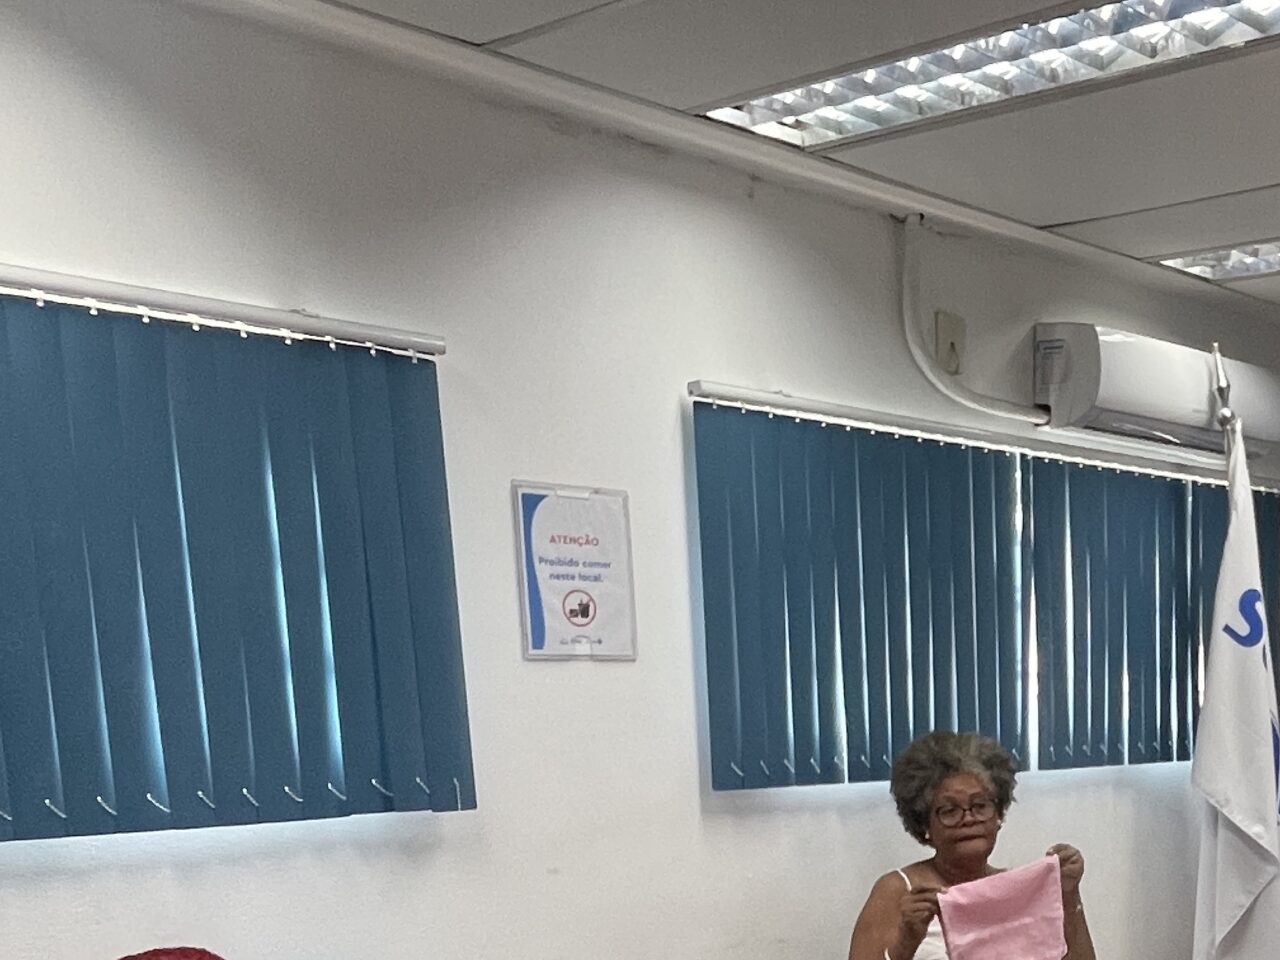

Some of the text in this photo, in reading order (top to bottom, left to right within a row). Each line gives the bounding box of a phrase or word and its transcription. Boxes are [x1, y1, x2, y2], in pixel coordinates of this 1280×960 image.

[549, 534, 599, 547] ATENÇÃO
[538, 556, 611, 569] Proibido comer
[549, 573, 576, 581] neste
